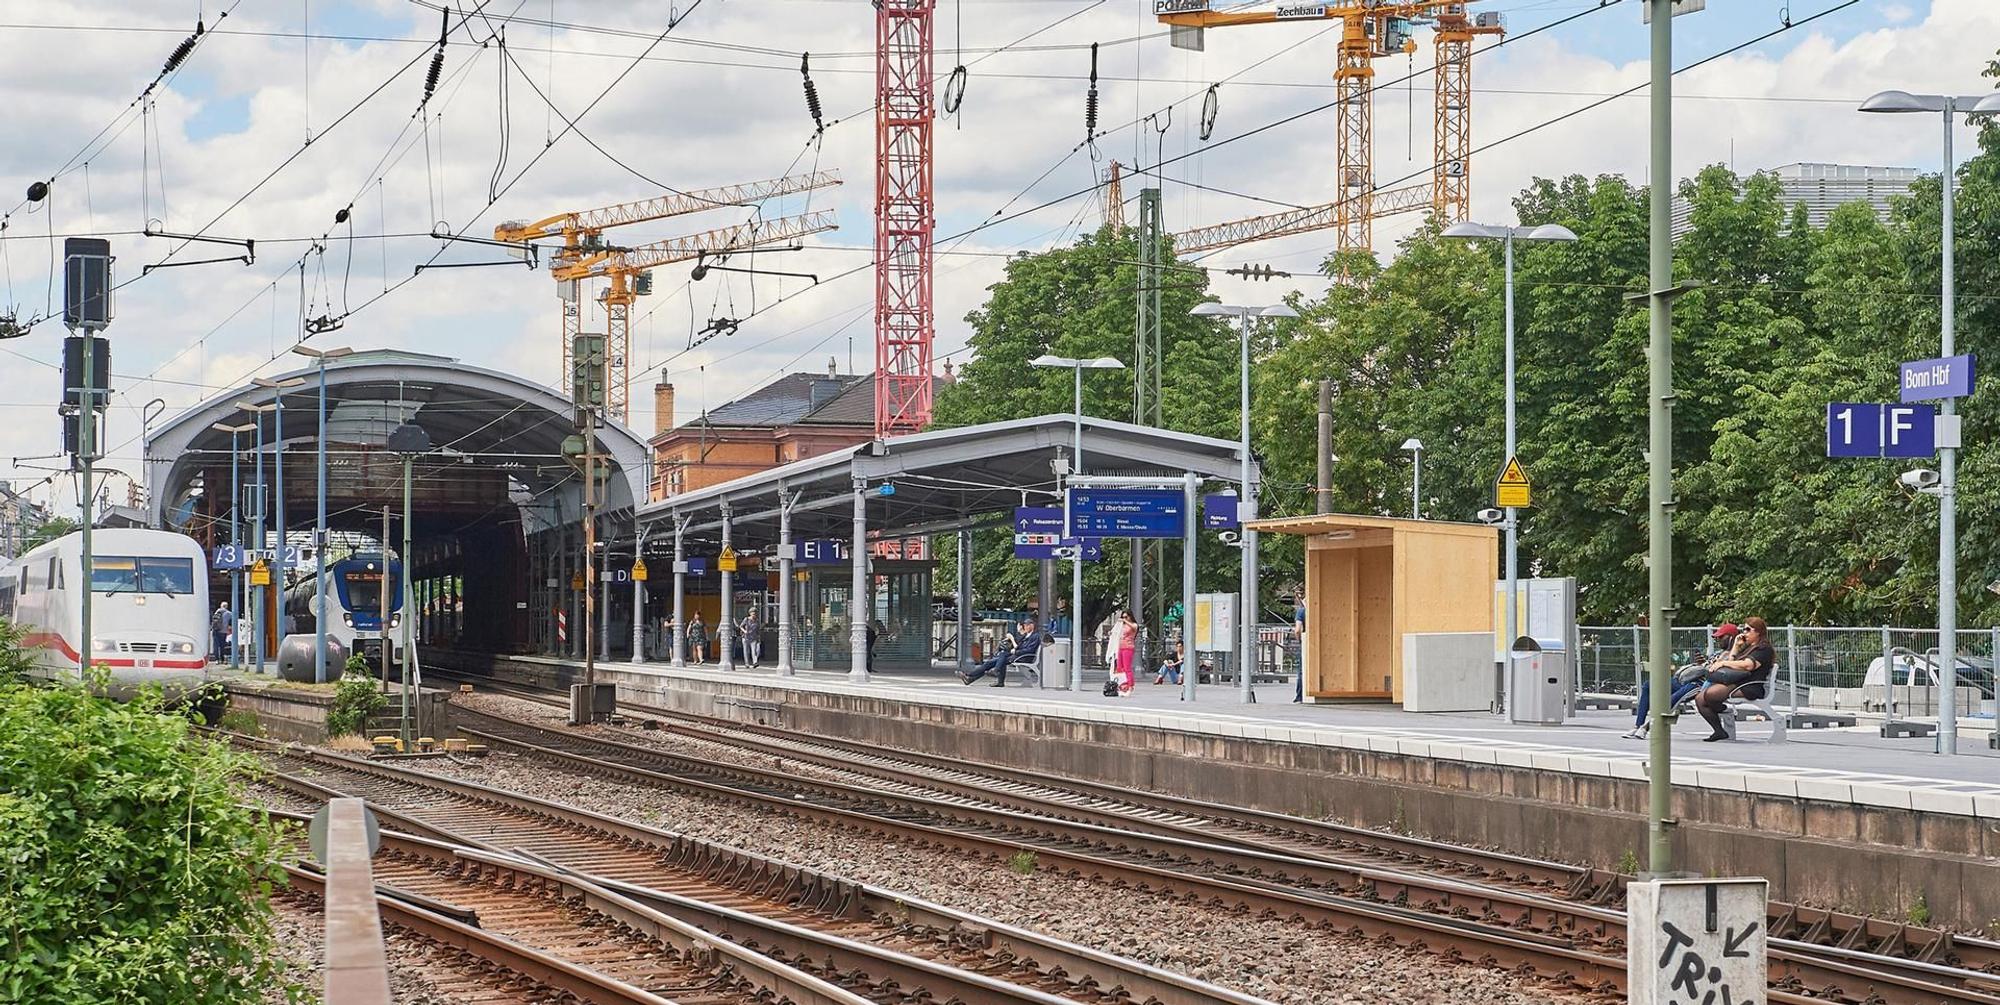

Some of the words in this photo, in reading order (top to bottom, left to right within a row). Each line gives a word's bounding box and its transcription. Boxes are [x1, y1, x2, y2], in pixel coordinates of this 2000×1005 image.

[1277, 6, 1316, 17] Zechbau
[1452, 162, 1461, 174] 2
[570, 307, 577, 315] 5
[616, 357, 623, 365] 4
[1905, 369, 1930, 389] Bonn
[1932, 364, 1950, 386] Hbf
[1837, 408, 1852, 445] 1
[1891, 408, 1914, 445] F
[1105, 504, 1141, 512] Oberbarmen
[225, 546, 236, 562] 3
[285, 546, 296, 563] 2
[804, 541, 816, 559] E
[832, 542, 840, 560] 1
[617, 569, 627, 581] D
